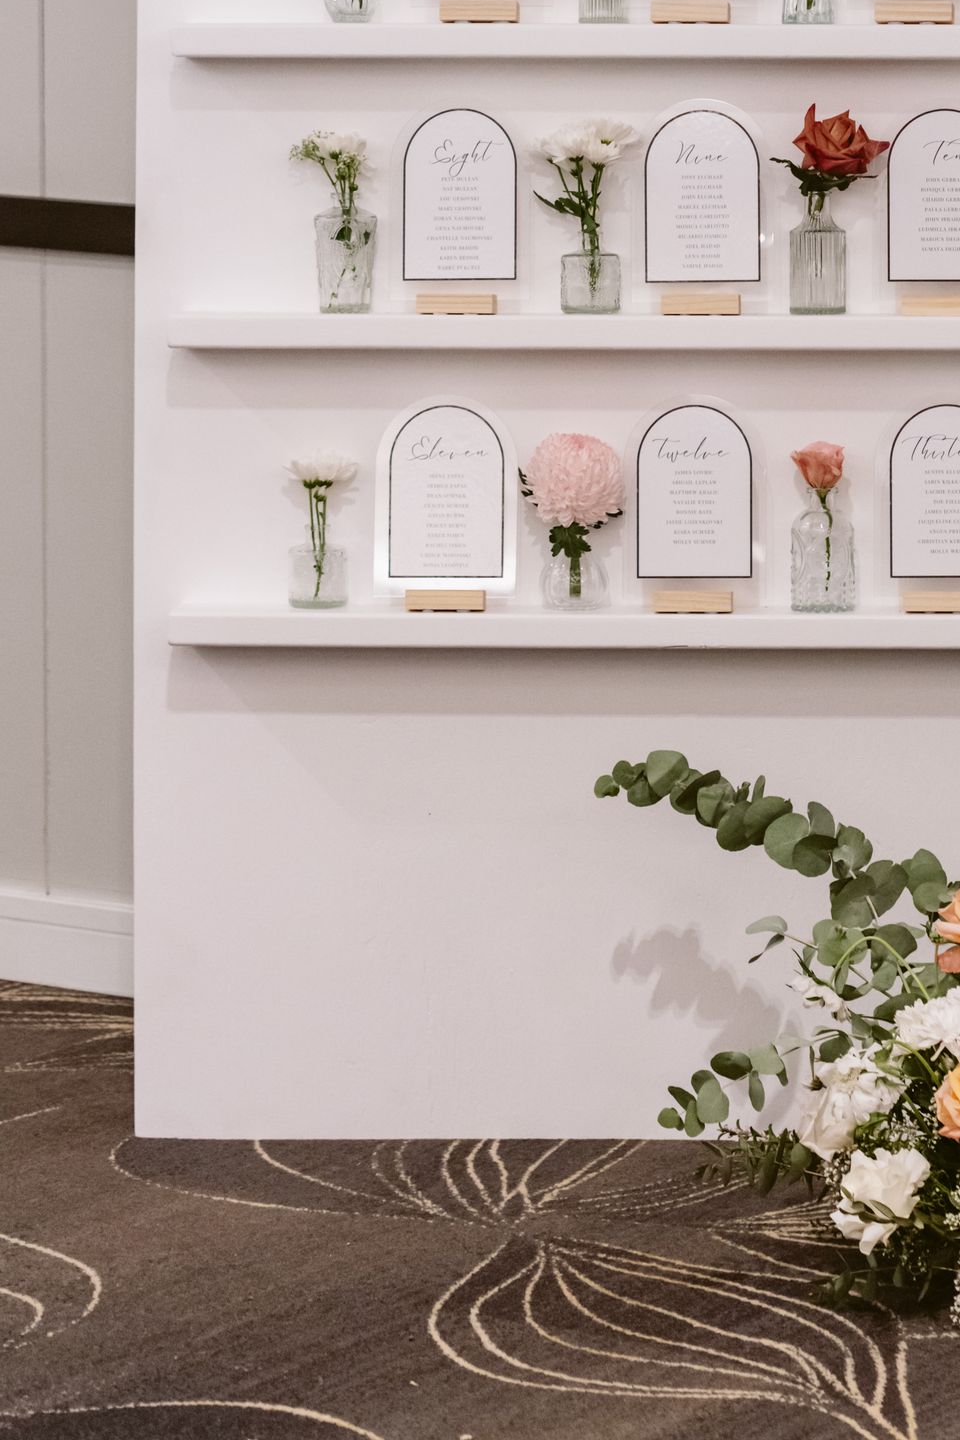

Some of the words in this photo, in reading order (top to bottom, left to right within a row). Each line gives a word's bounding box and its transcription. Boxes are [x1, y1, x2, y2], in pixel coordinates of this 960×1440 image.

[431, 139, 504, 177] Eight
[675, 141, 728, 164] Nine
[408, 435, 488, 461] Eleven
